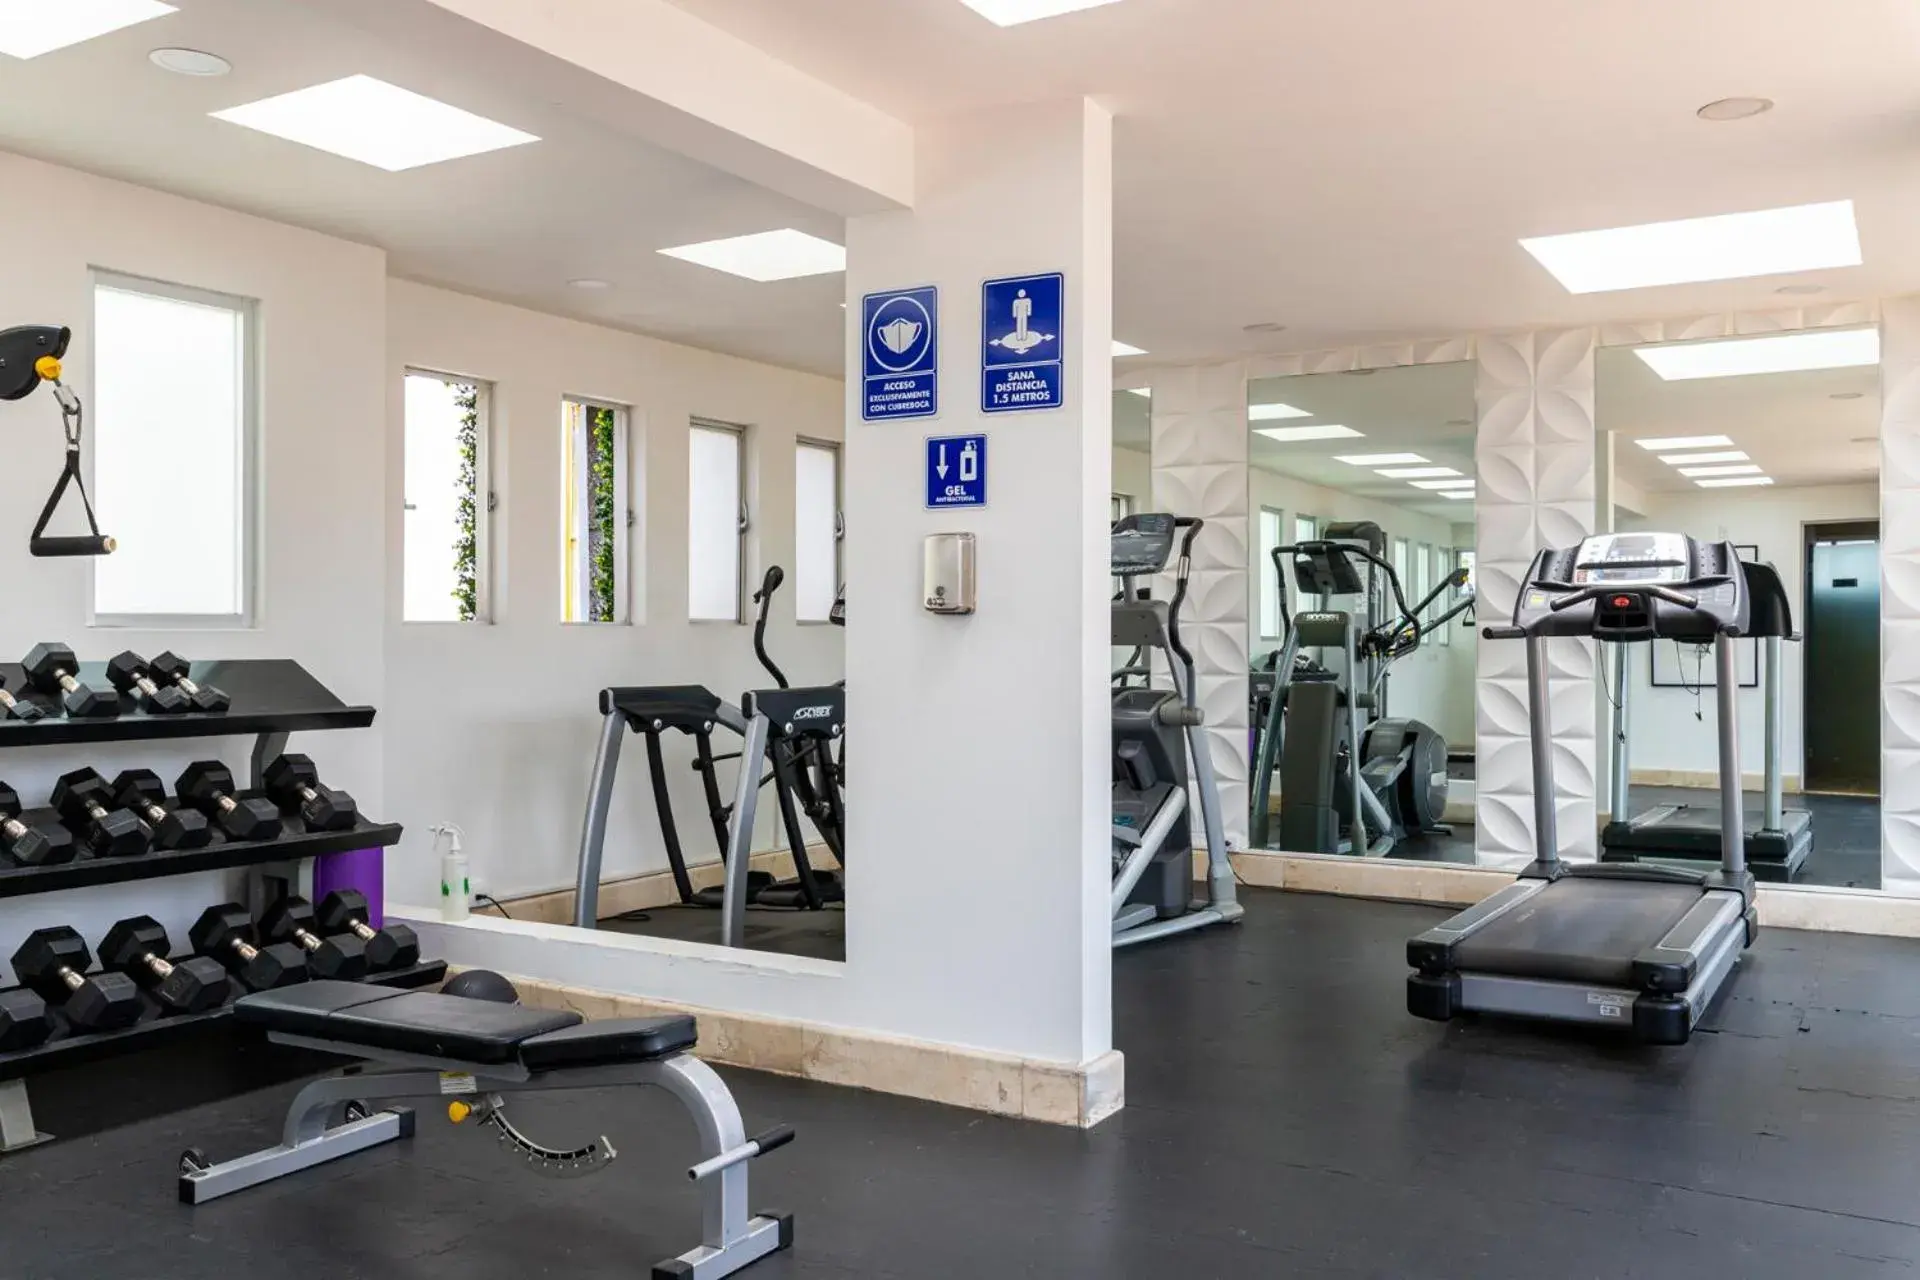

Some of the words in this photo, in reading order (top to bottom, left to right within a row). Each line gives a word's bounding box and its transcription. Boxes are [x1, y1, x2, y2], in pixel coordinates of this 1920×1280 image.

[1007, 370, 1035, 381] SANA
[884, 380, 916, 390] ACCESO
[995, 380, 1047, 392] DISTANCIA
[870, 390, 930, 402] EXCLUSIVAMENTE
[993, 393, 1009, 404] 1.5
[1011, 391, 1050, 402] METROS
[870, 404, 886, 412] CON
[887, 400, 930, 411] CUBREBOCA
[945, 485, 967, 496] GEL
